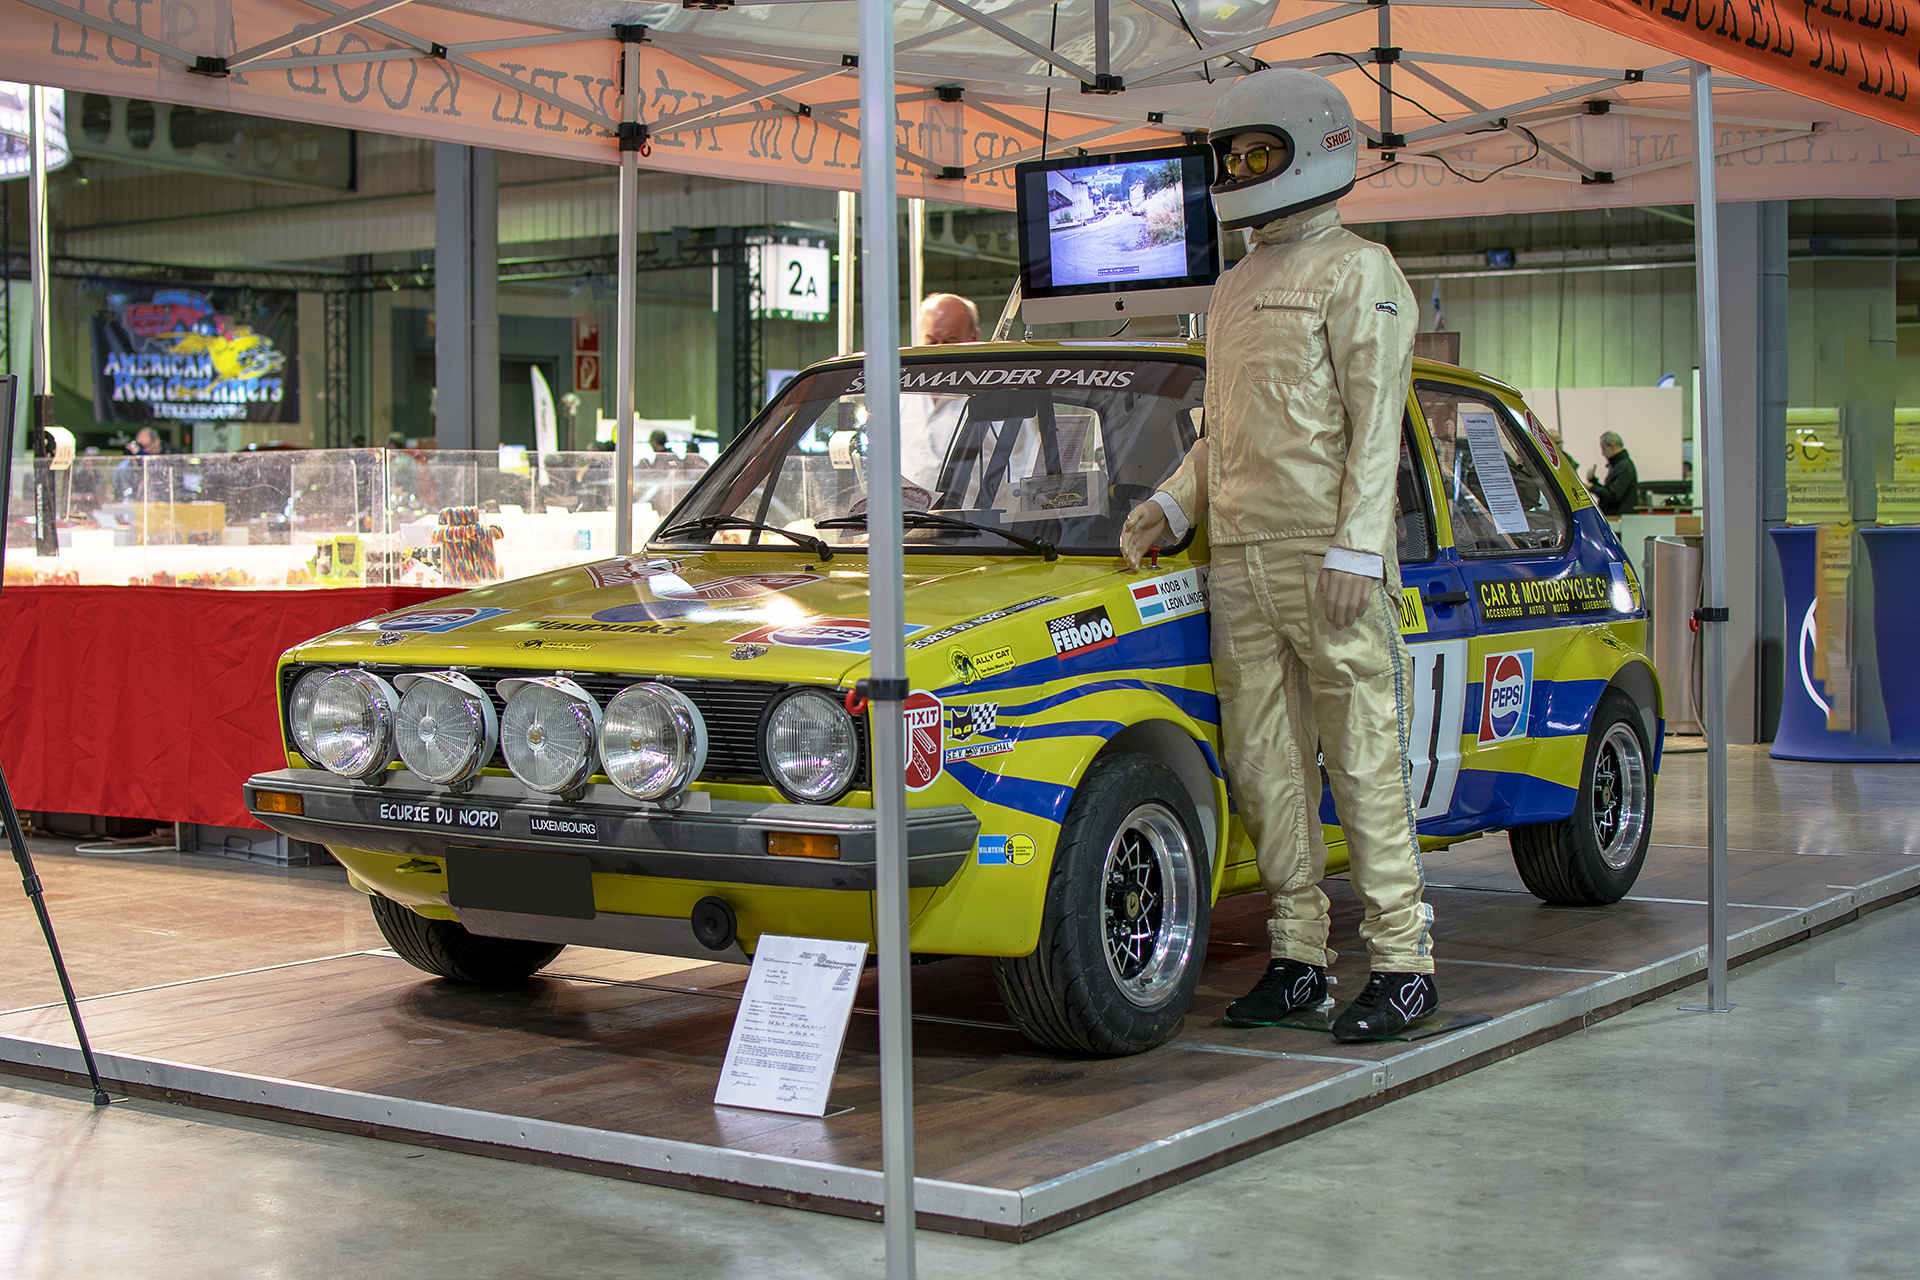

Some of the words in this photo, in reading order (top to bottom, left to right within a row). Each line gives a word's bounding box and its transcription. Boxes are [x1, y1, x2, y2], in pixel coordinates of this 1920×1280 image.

[1325, 129, 1351, 149] SHOEI
[103, 351, 212, 379] AMERICAN
[112, 371, 284, 403] Roadrunners
[1046, 369, 1136, 388] PARIS
[153, 402, 248, 420] LUXEMBOURG
[1158, 579, 1181, 595] KOOB
[1480, 582, 1509, 607] CAR
[1510, 582, 1521, 605] &
[1520, 577, 1596, 604] MOTORCYCLE
[1164, 597, 1185, 611] LEON
[1486, 606, 1523, 619] ACCESSOIRES
[1529, 604, 1546, 615] AUTOS
[1553, 602, 1570, 613] MOTOS
[905, 629, 956, 649] ECURIE
[952, 622, 974, 631] DU
[971, 610, 1007, 625] NORD
[1050, 616, 1113, 654] FERODO
[976, 653, 994, 666] ALLY
[995, 648, 1010, 660] CAT
[1491, 684, 1523, 709] PEPSI
[946, 750, 964, 761] S.E.V.
[977, 742, 1012, 755] MARCHAL
[379, 803, 430, 822] ECURIE
[435, 806, 453, 824] DU
[459, 809, 499, 828] NORD
[531, 818, 596, 835] LUXEMBOURG
